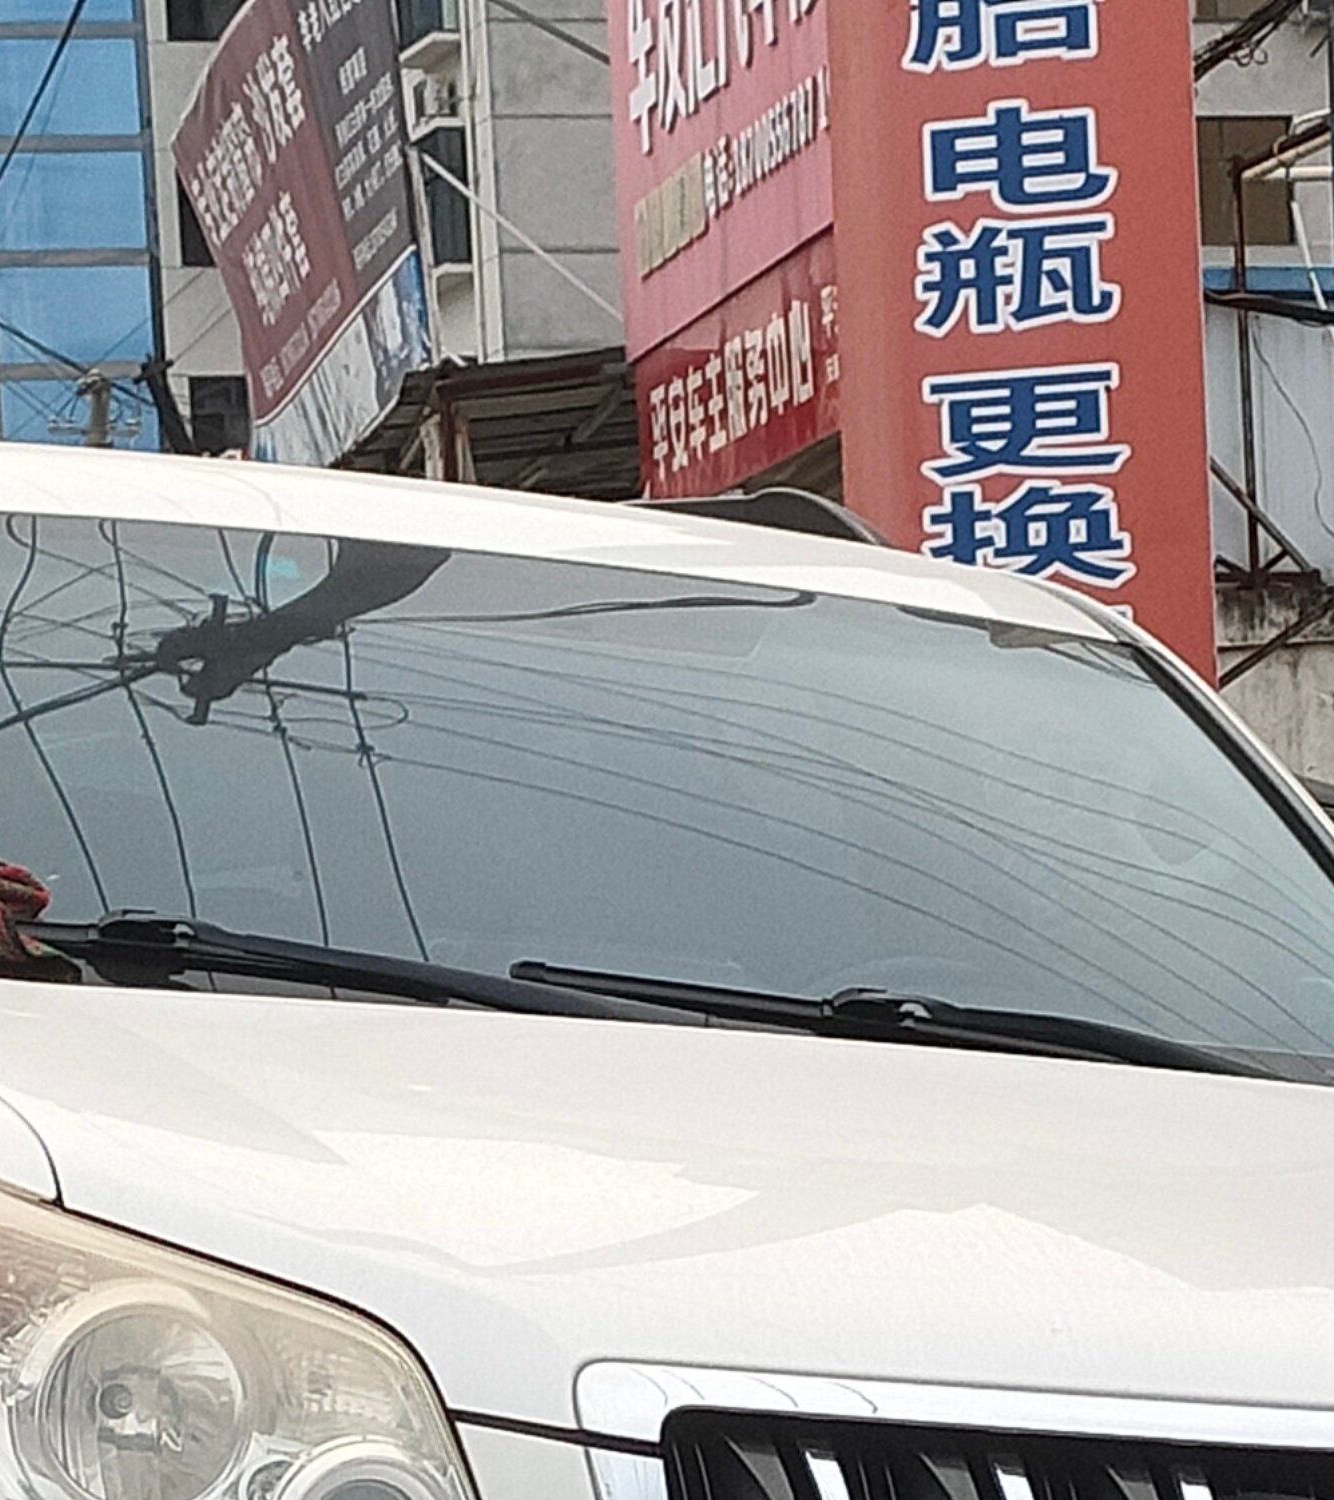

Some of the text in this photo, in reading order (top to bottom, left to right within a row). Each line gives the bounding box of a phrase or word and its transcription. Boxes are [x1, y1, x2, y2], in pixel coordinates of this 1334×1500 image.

[649, 299, 815, 482] 平安车主服务中心
